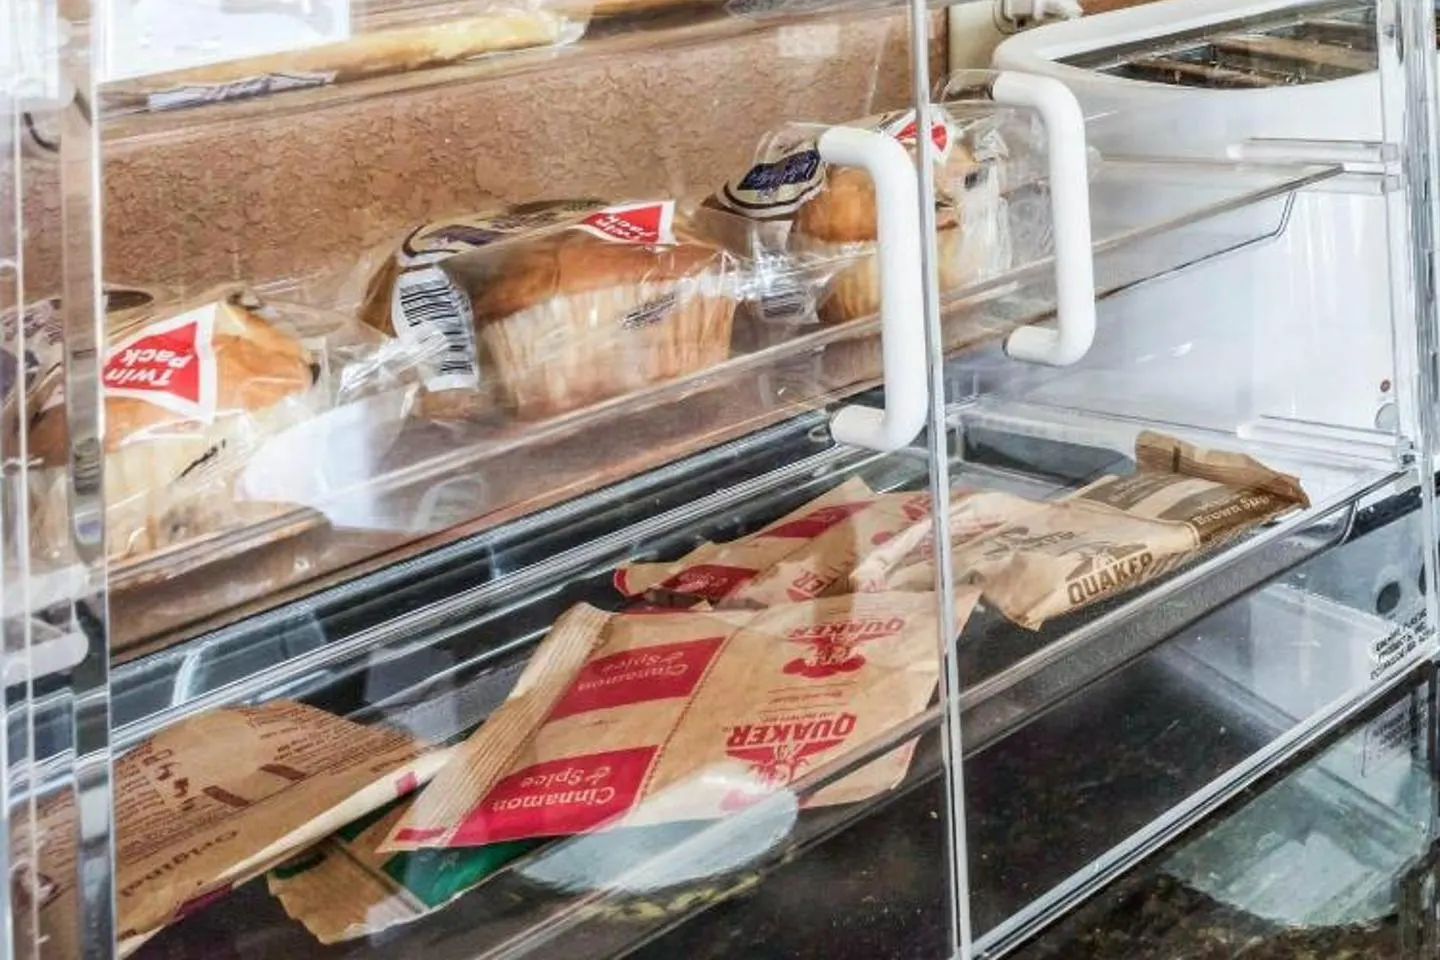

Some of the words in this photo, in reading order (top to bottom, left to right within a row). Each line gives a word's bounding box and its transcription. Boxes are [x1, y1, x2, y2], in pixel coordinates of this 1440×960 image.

[119, 347, 195, 369] Pack
[104, 367, 173, 386] Twin
[1067, 551, 1153, 606] QUAKER
[788, 617, 906, 639] QUAKER
[725, 712, 858, 747] QUAKER
[520, 768, 586, 788] Spice
[587, 765, 612, 786] &
[492, 786, 616, 812] Cinnamon
